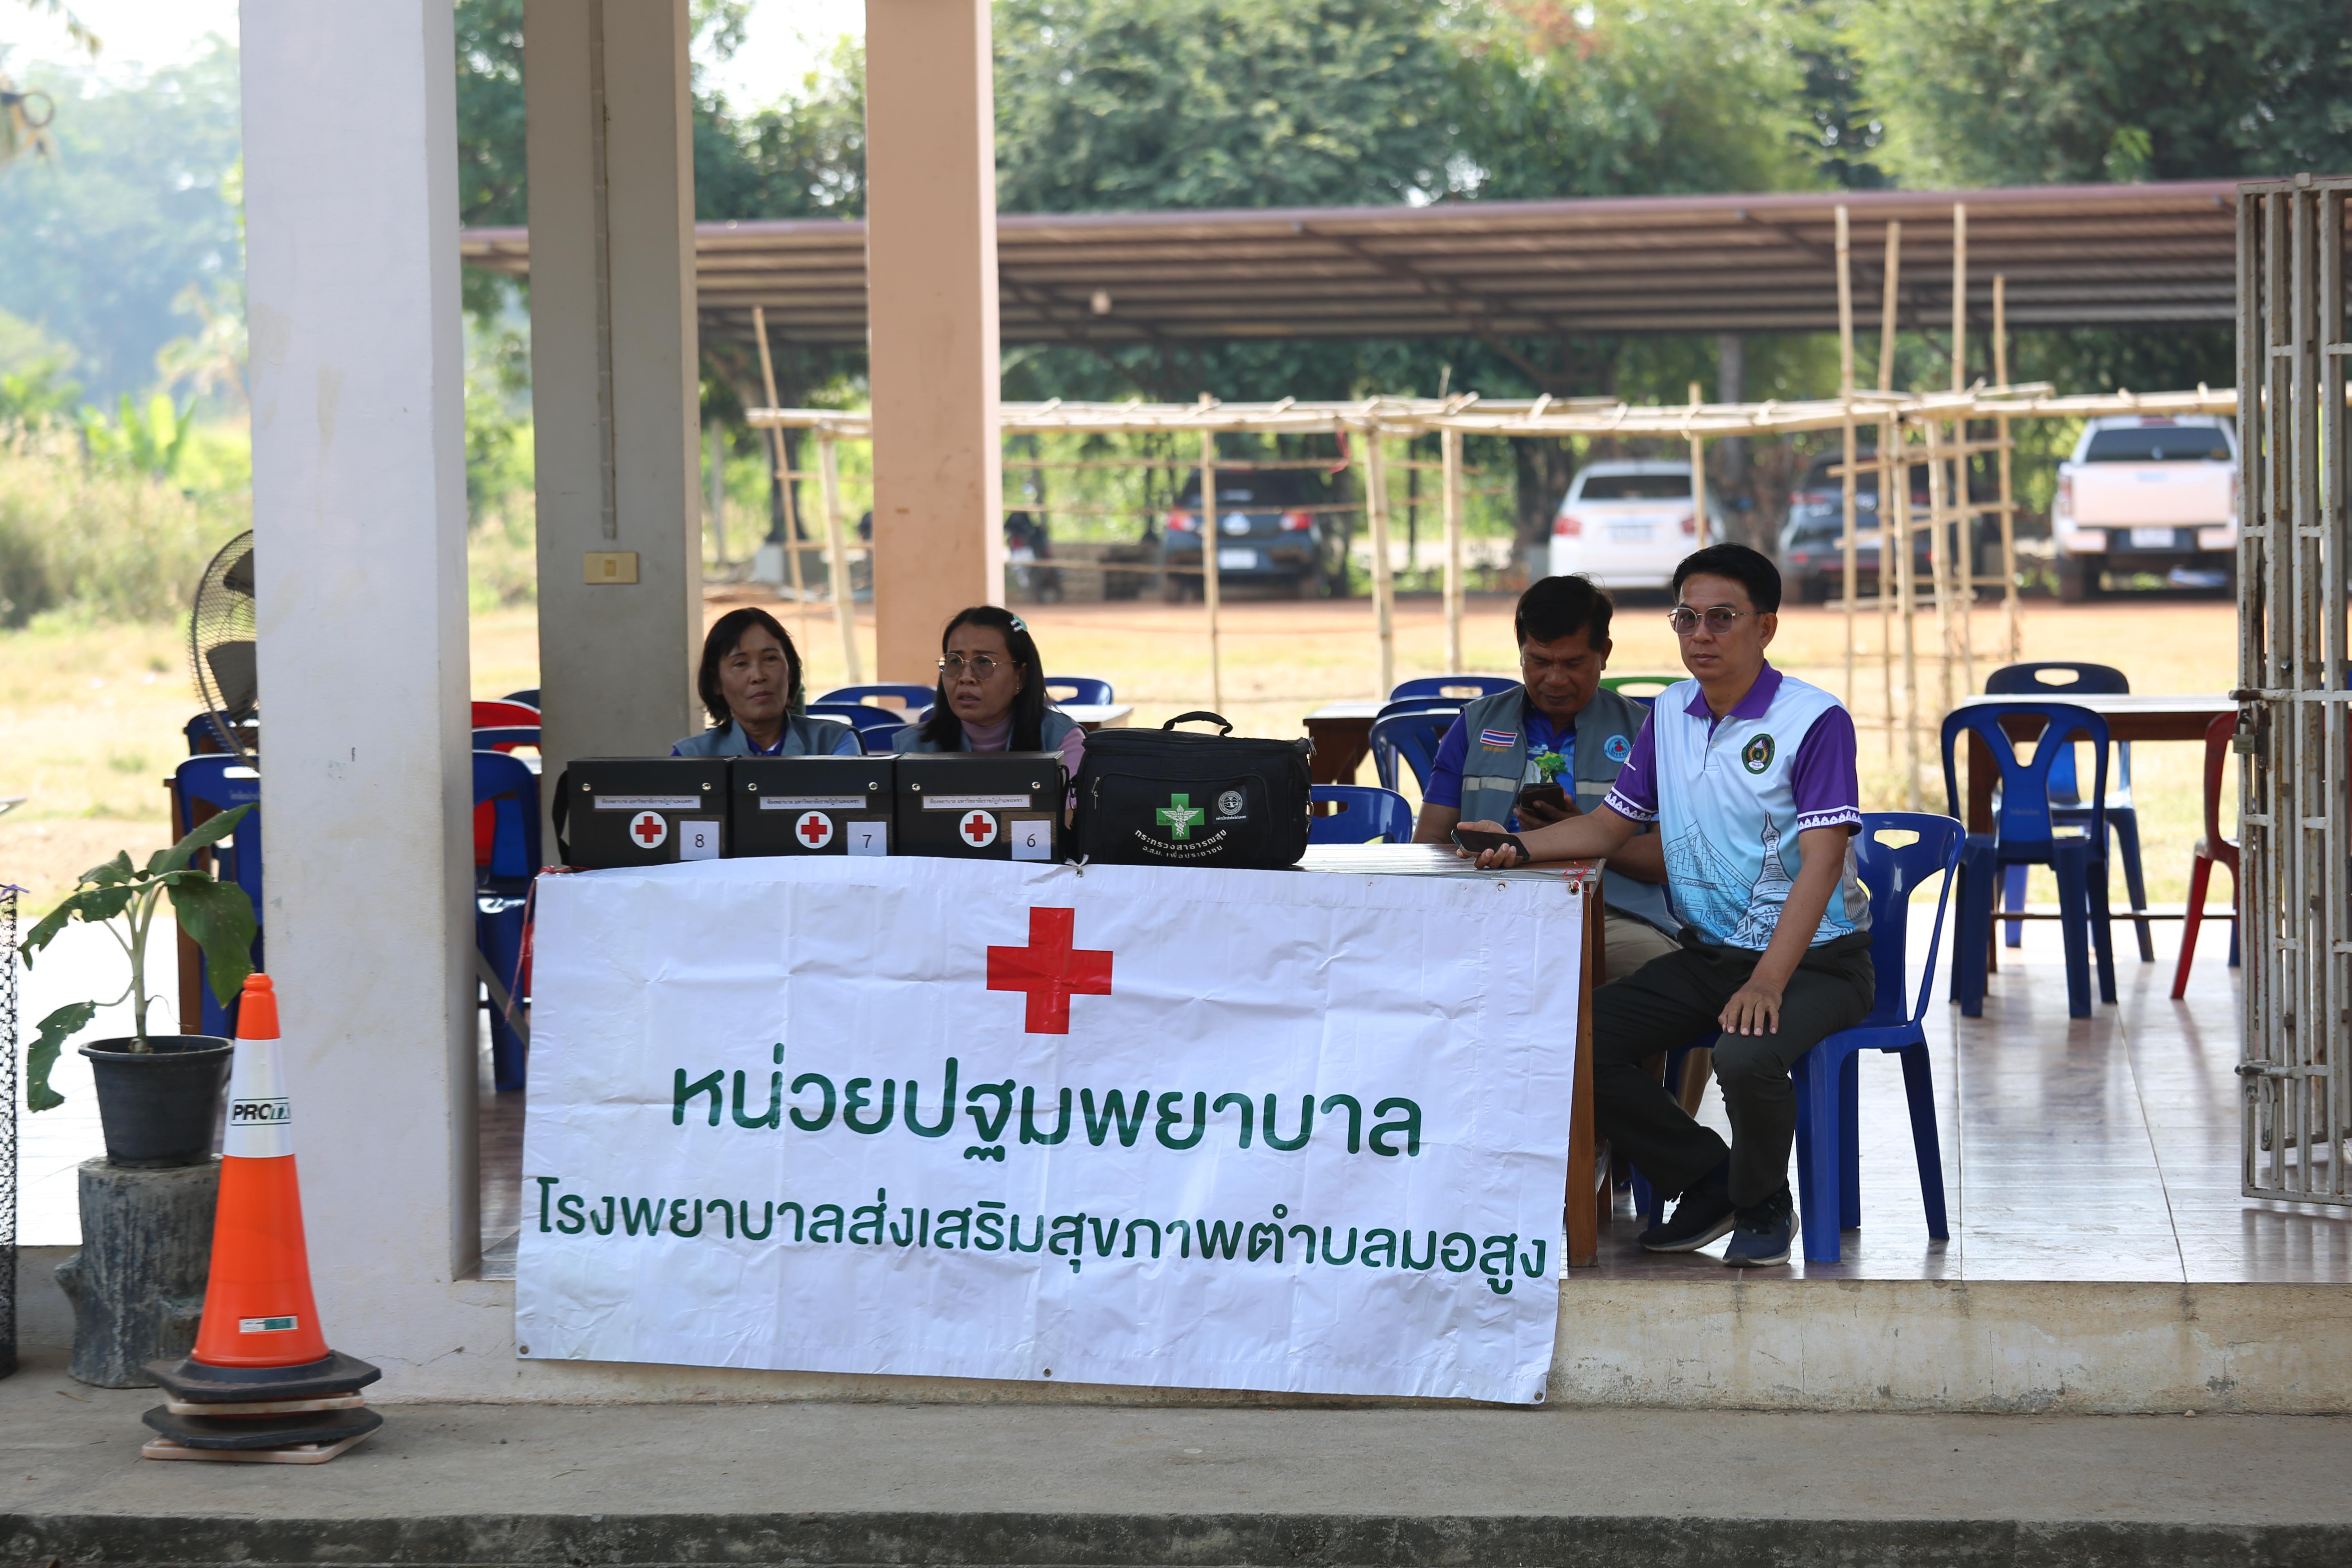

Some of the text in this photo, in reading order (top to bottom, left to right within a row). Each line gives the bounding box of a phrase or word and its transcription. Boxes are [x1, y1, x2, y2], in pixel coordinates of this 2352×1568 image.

[695, 834, 704, 848] 8
[862, 834, 872, 849] 7
[1027, 833, 1036, 848] 6
[1135, 829, 1227, 851] กระทรวงสาธารณสุข
[1143, 845, 1223, 858] อ.ส.ม. เพื่อประชาชน
[672, 1042, 1422, 1163] หน่วยปฐมพยาบาล
[536, 1176, 1547, 1295] โรงพยาบาลส่งเสริมสุขภาพตำบลมอสูง
